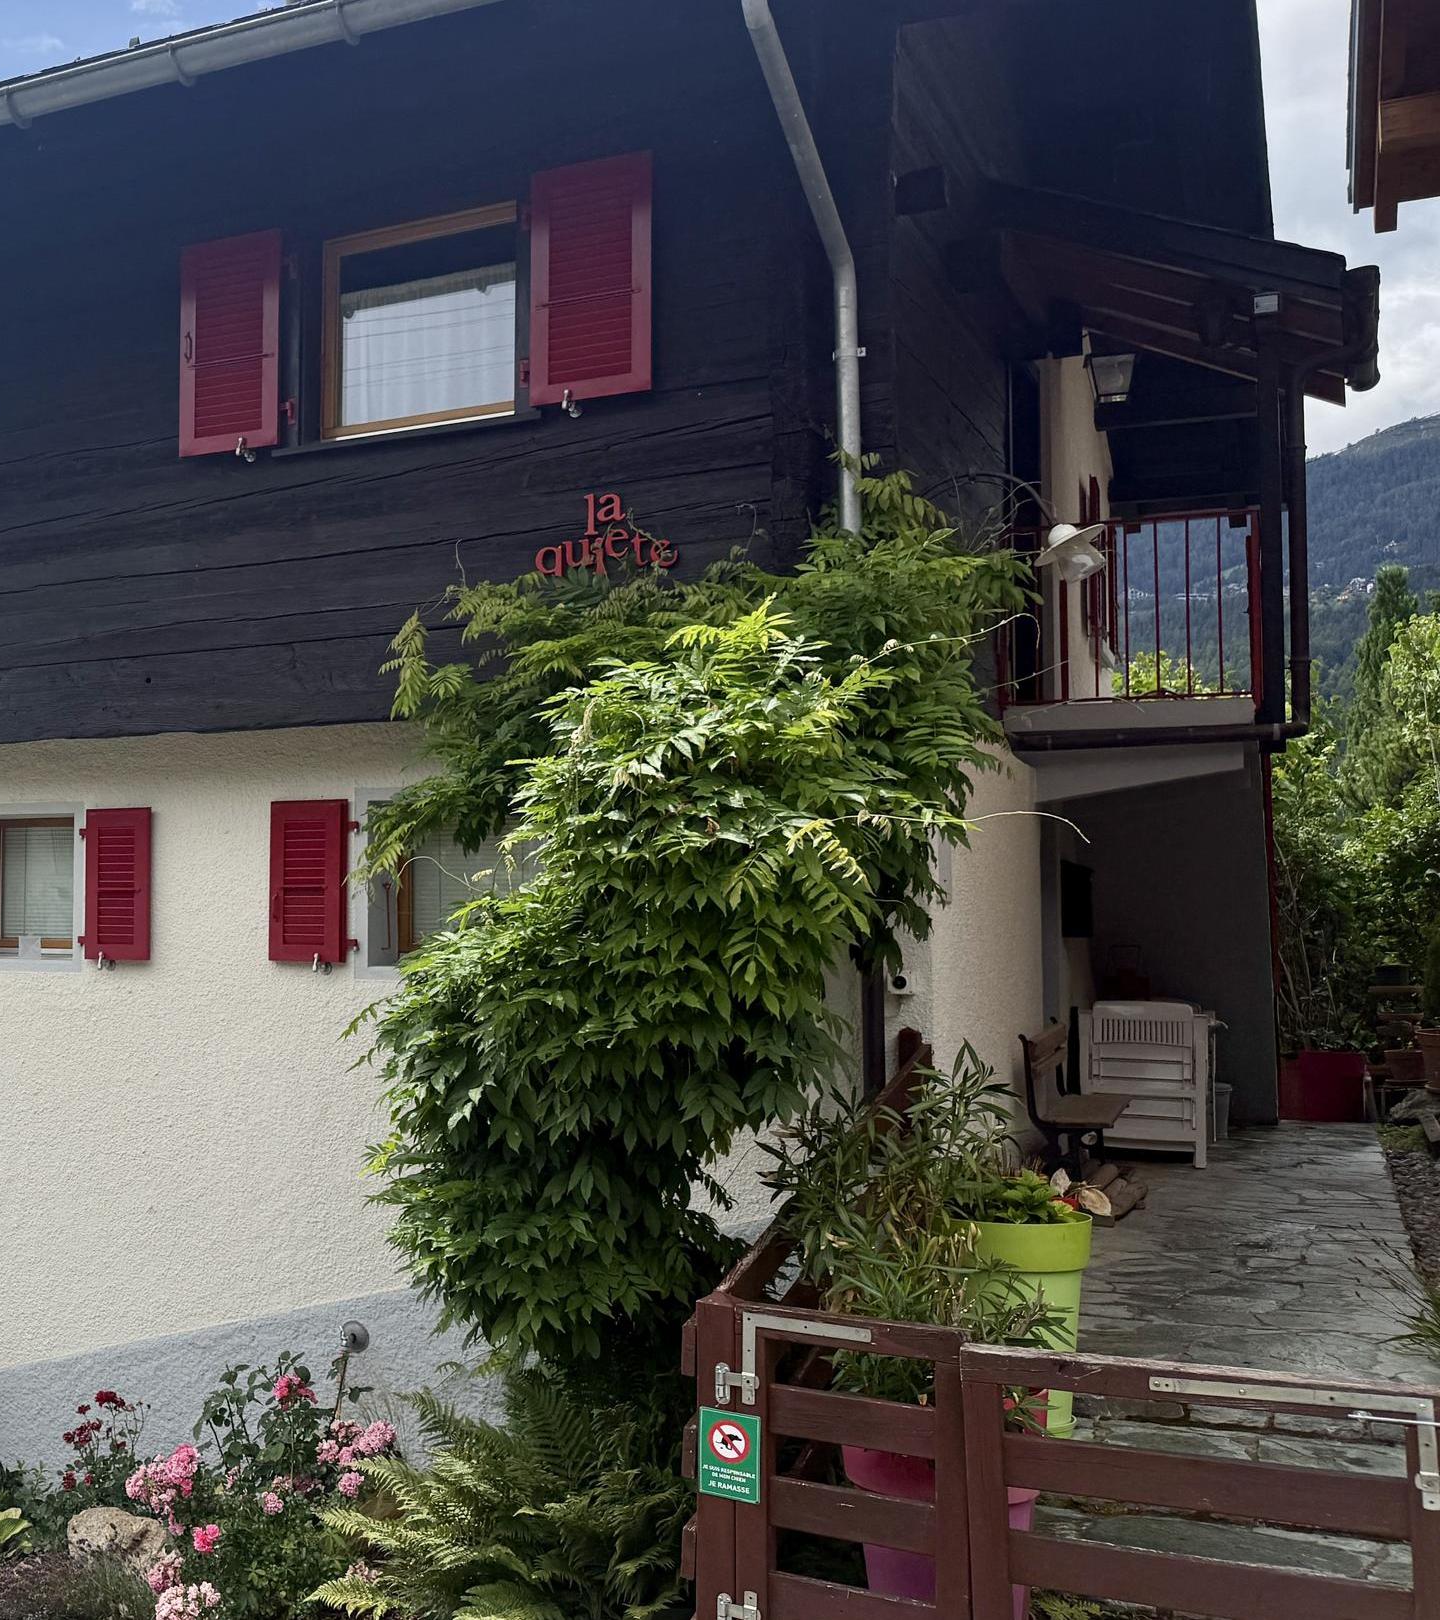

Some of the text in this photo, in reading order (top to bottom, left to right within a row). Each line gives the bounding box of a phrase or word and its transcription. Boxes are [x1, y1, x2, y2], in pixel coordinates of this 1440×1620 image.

[584, 492, 626, 535] la
[720, 1467, 756, 1479] RESPONSABLE
[718, 1482, 750, 1494] RAMASSE
